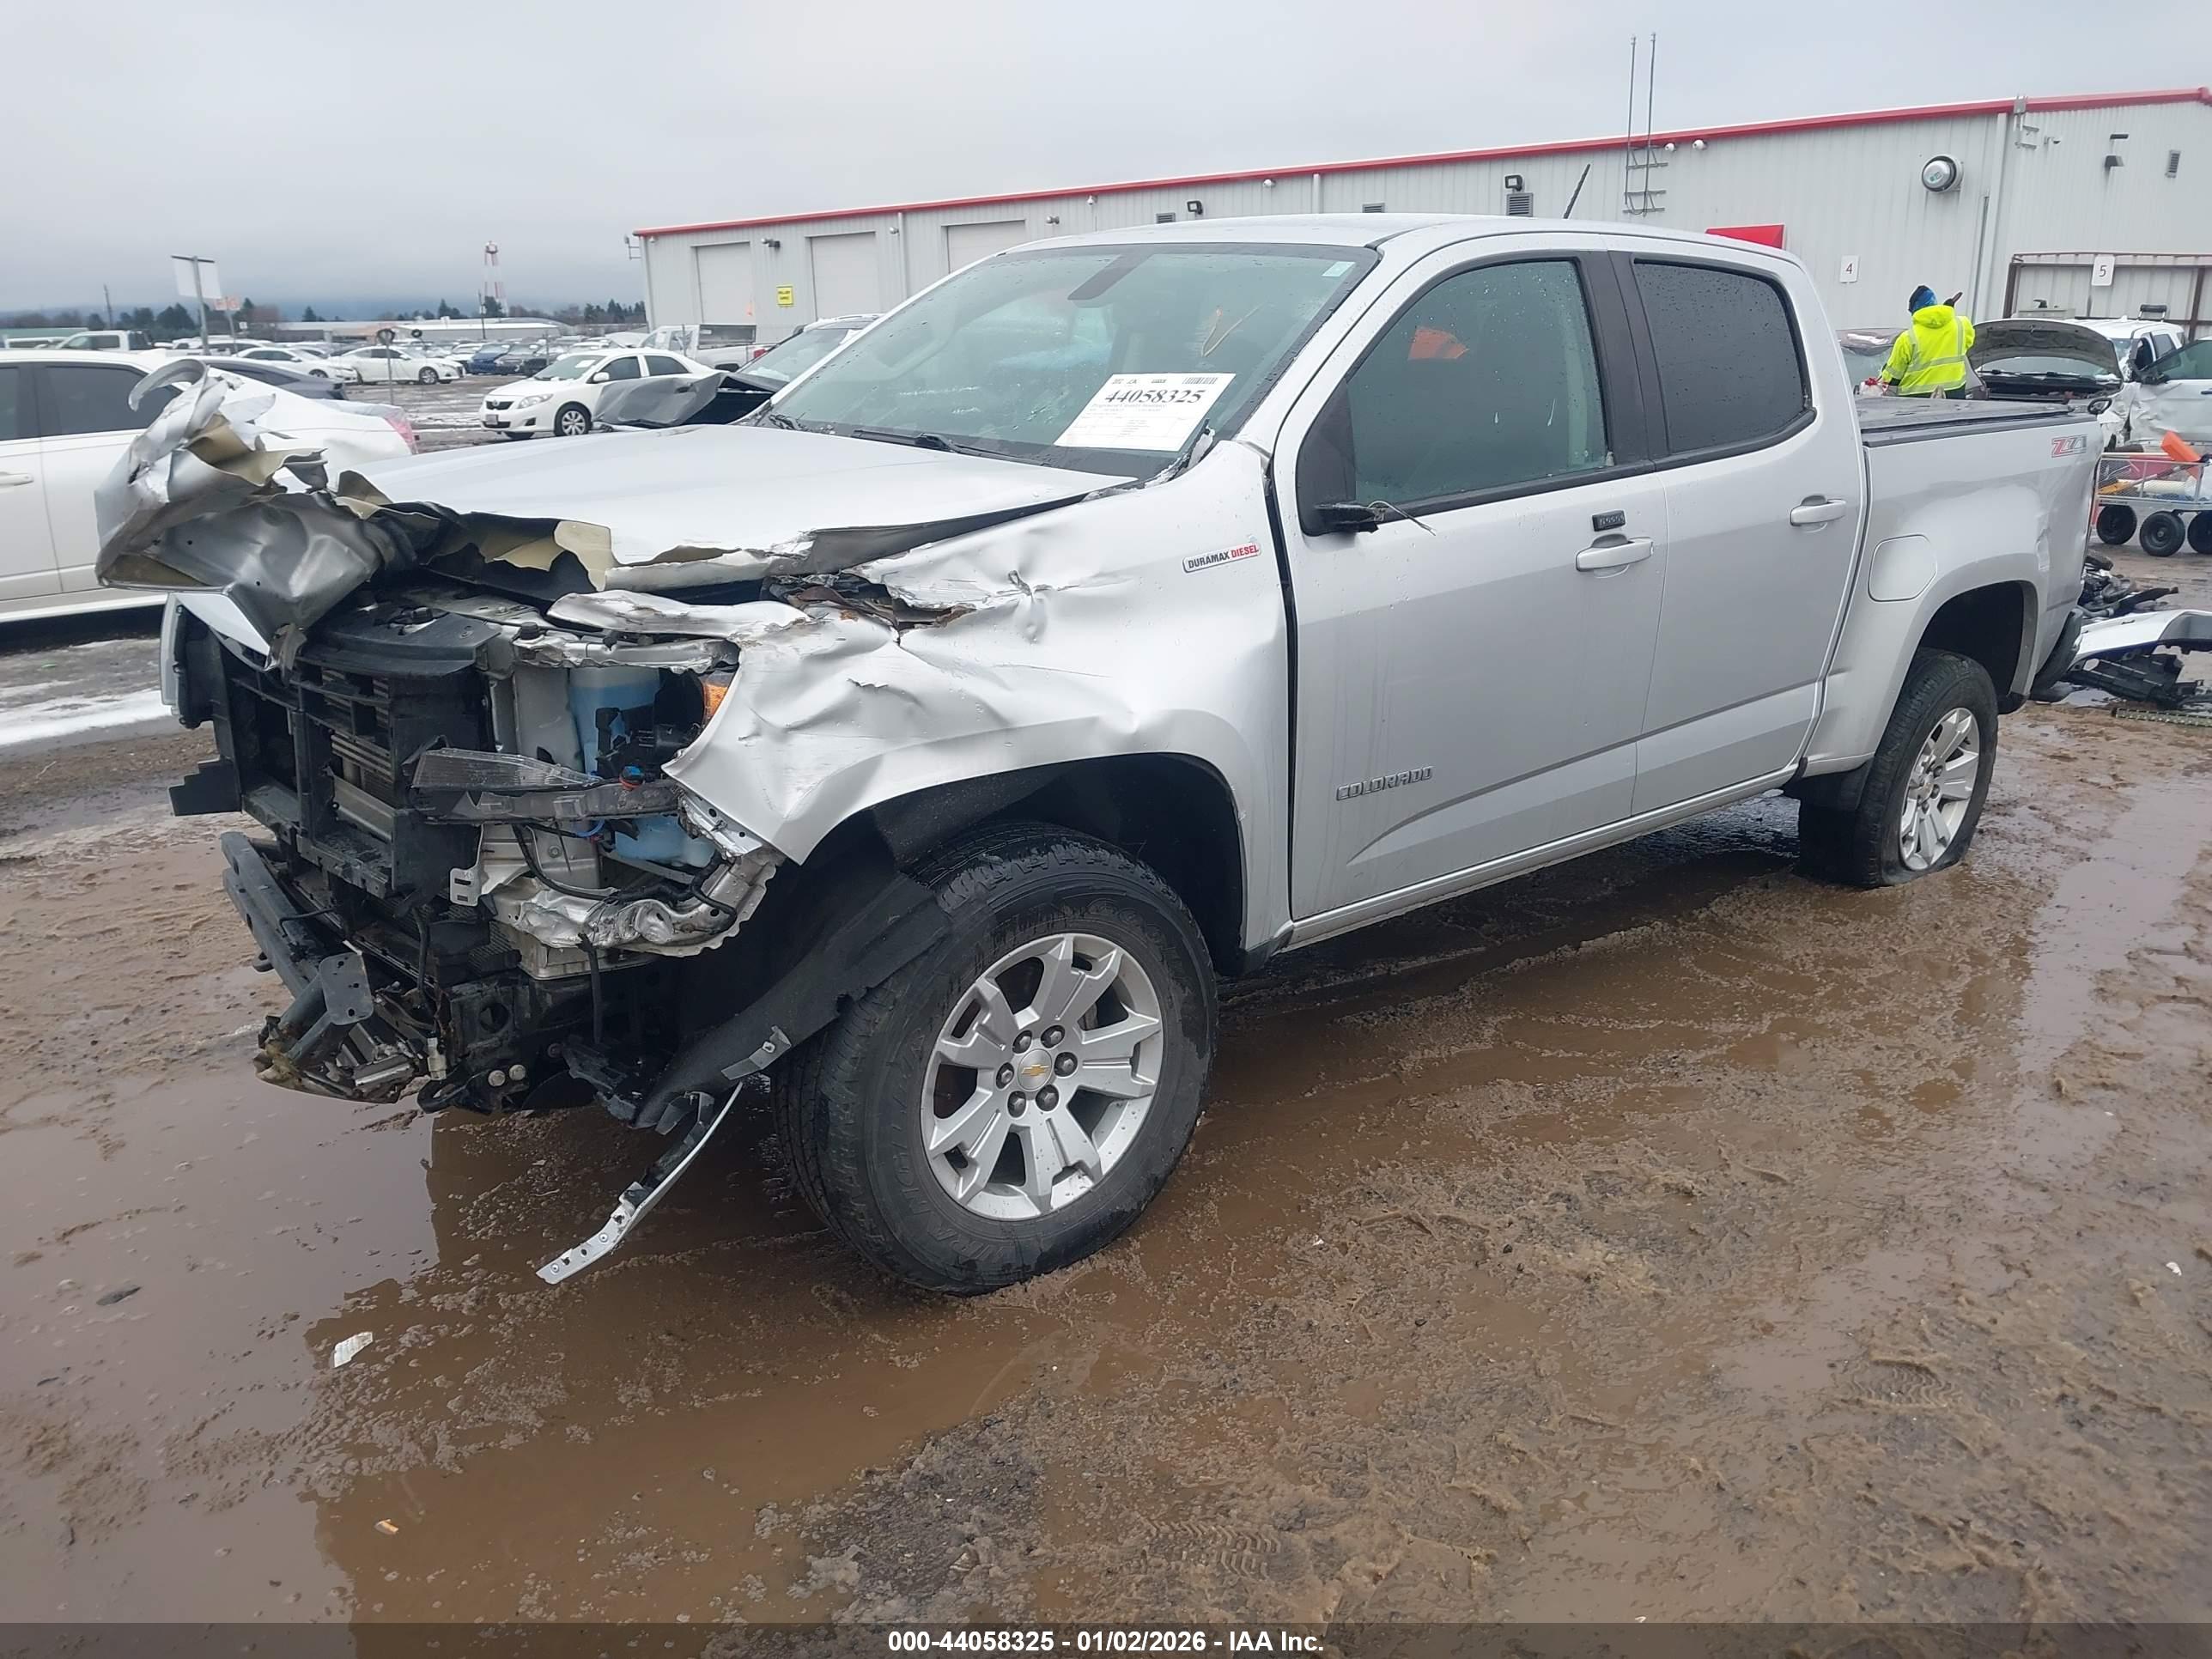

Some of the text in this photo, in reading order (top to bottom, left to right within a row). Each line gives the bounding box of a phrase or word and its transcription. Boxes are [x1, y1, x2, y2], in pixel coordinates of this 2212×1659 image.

[1845, 263, 1853, 275] 4
[2099, 264, 2107, 277] 5
[1104, 389, 1206, 404] 44058325
[1188, 544, 1260, 569] DURAMAX DIESEL
[1336, 766, 1434, 801] COLORADO
